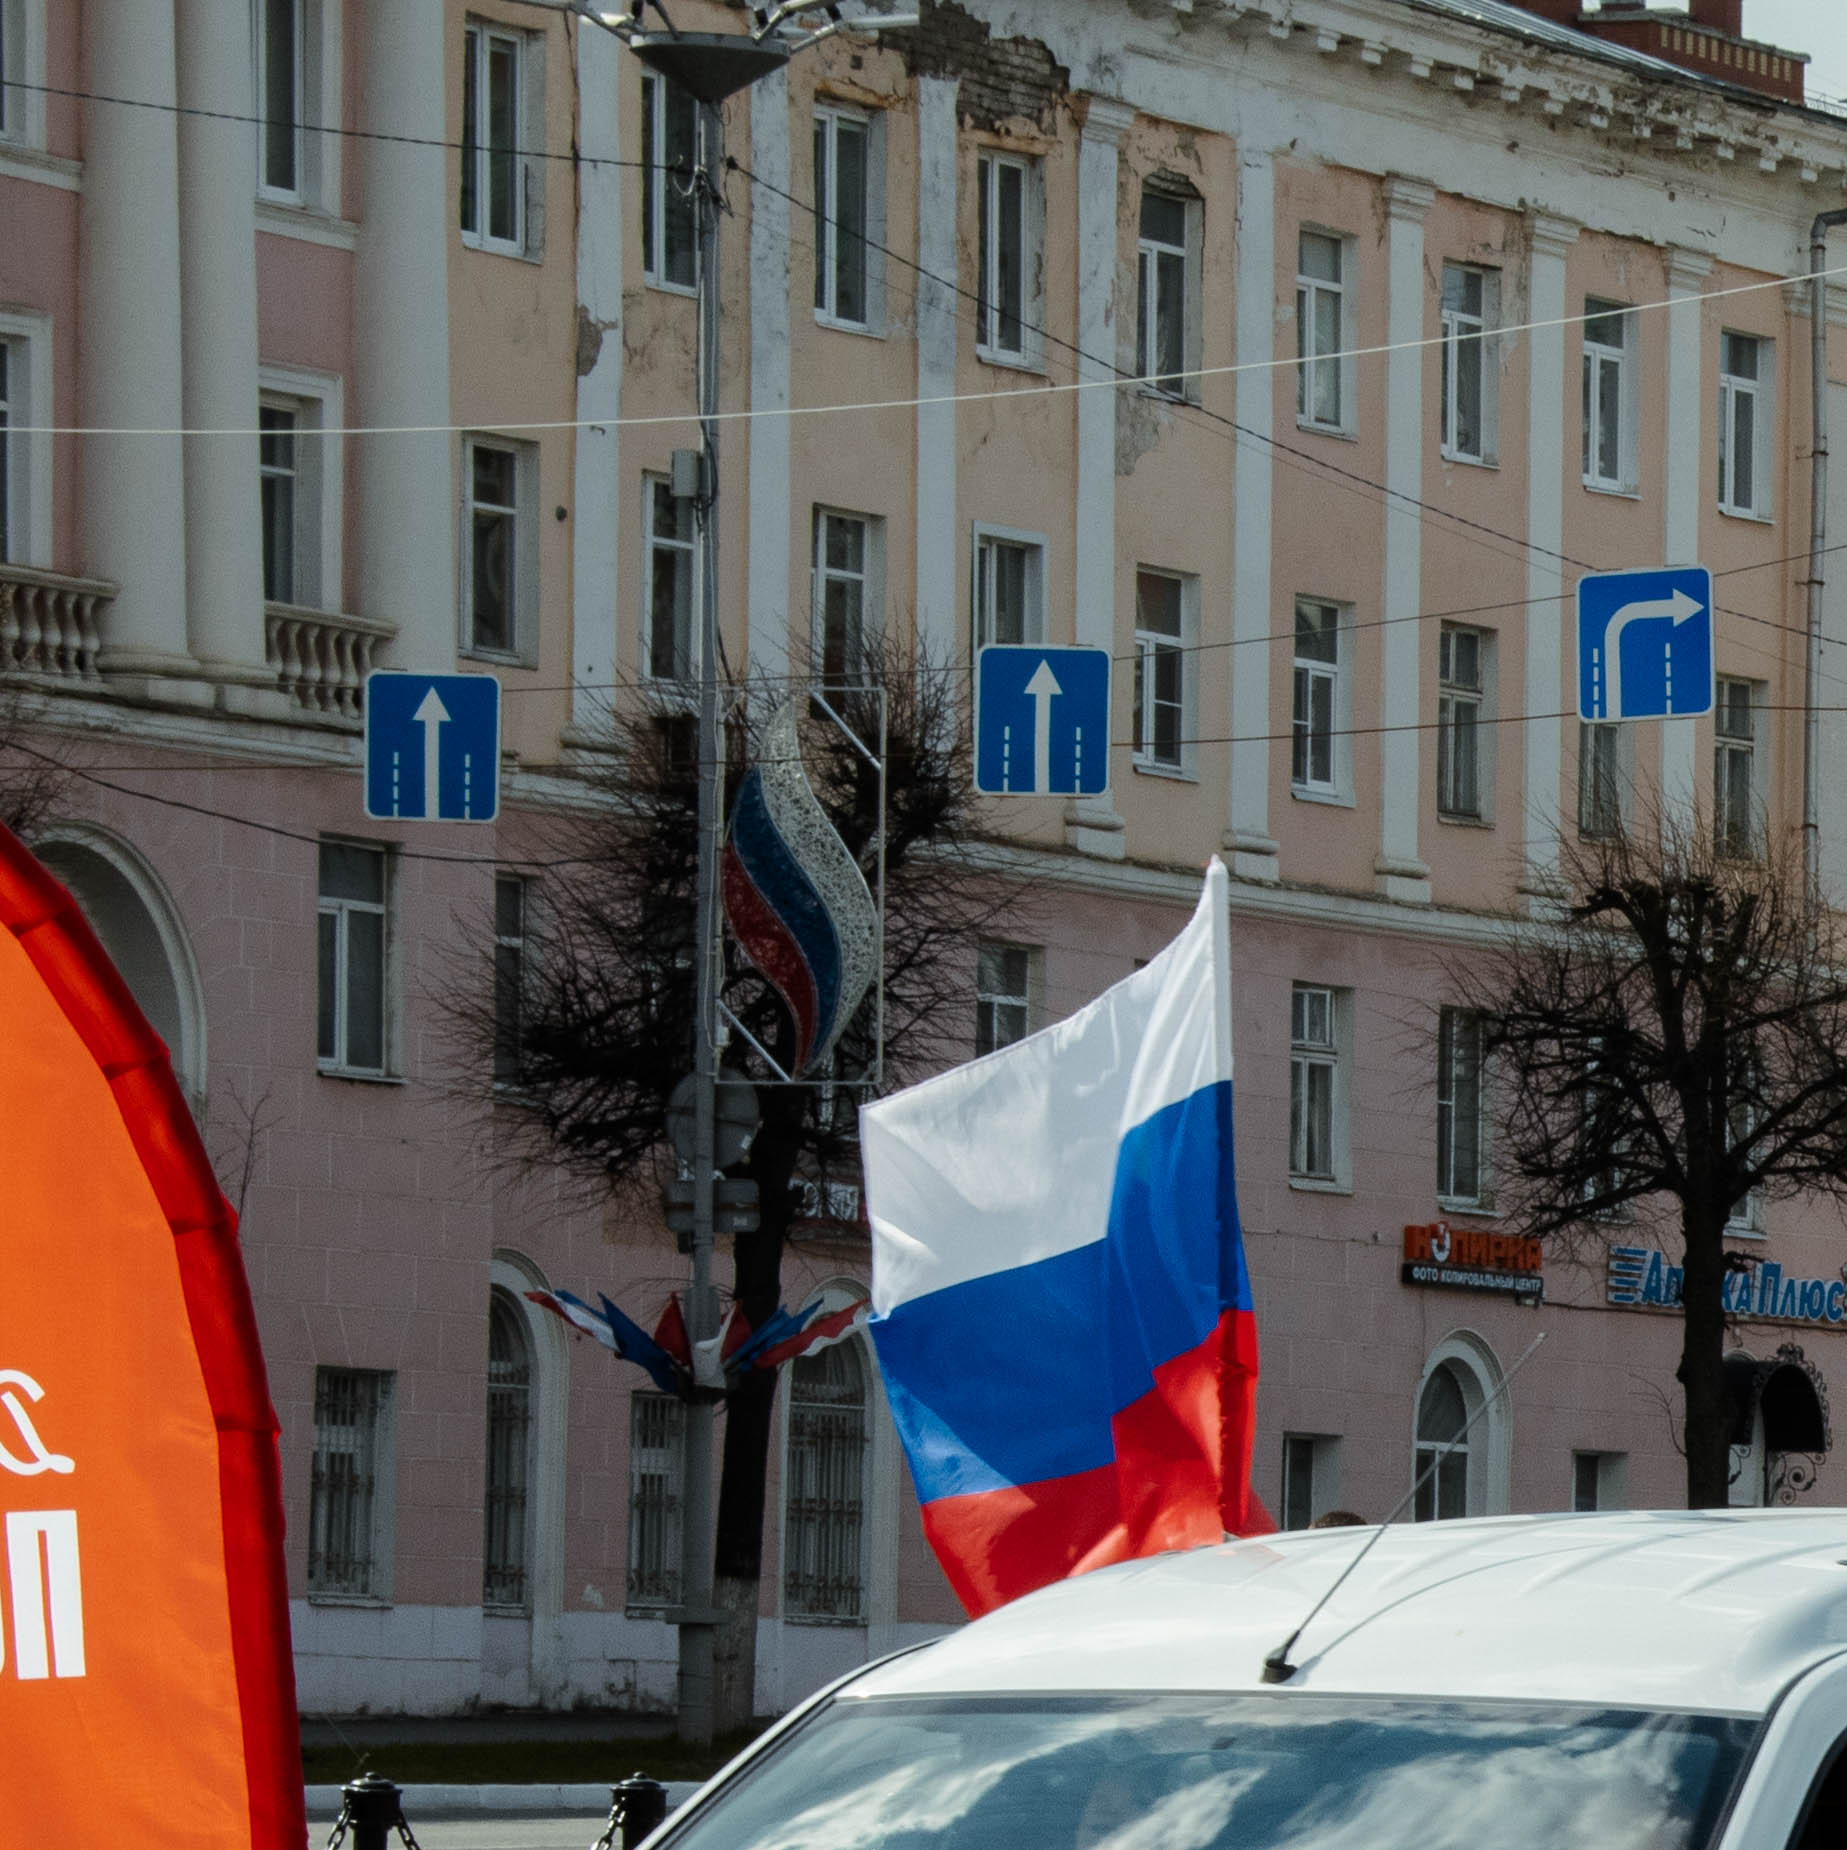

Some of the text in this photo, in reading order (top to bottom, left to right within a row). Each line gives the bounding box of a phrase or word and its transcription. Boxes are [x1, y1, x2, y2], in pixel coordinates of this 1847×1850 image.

[1412, 1266, 1541, 1292] ФОТО КОПИРОВАЛЬНЫЙ ЦЕНТР
[1641, 1249, 1752, 1314] АПКА
